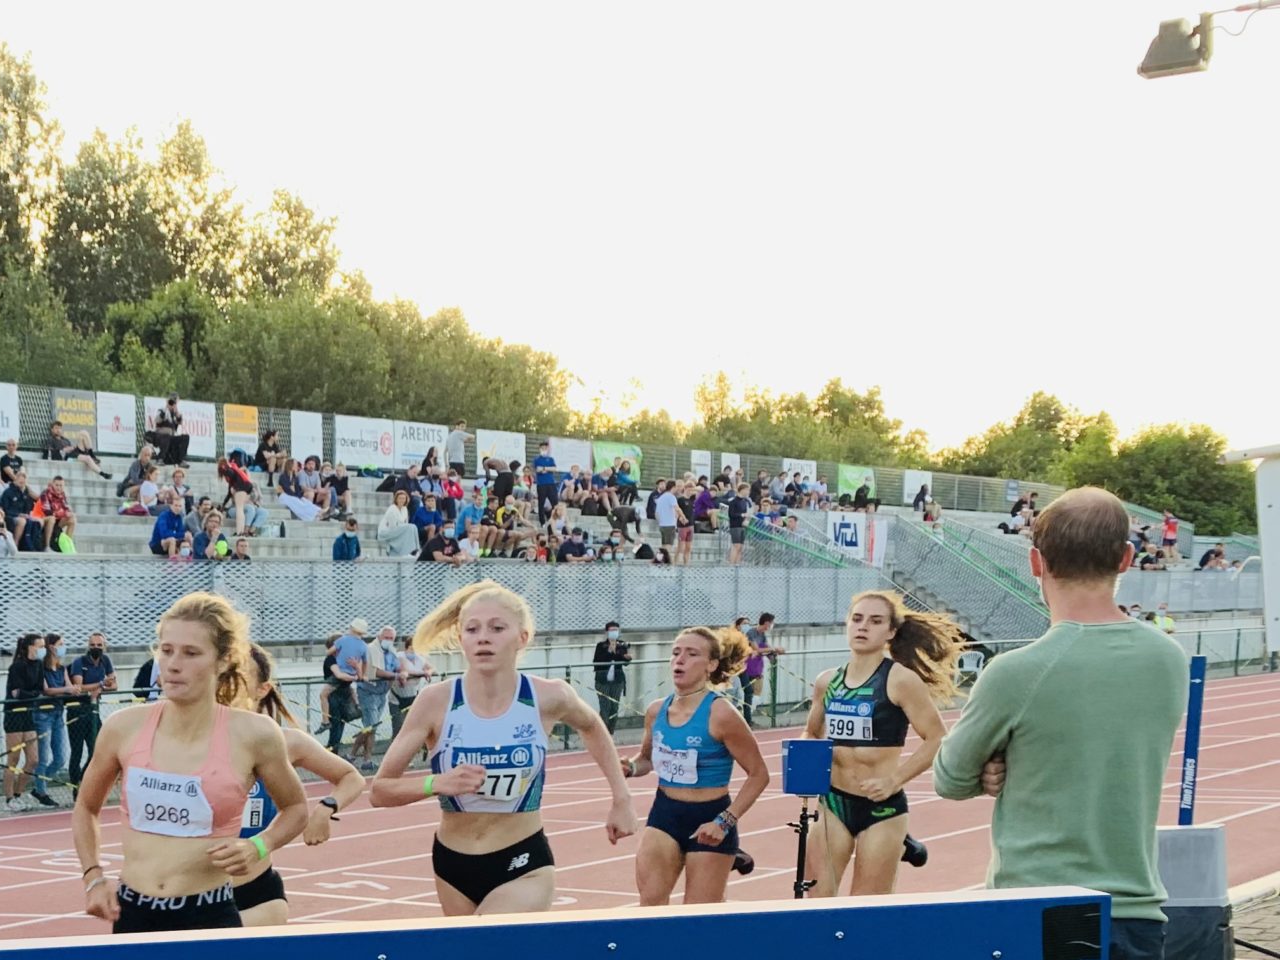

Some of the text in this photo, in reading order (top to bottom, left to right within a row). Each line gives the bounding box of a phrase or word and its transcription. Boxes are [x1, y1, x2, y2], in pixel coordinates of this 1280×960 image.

[401, 426, 443, 443] ARENTS
[828, 702, 856, 714] Allianz
[829, 718, 855, 736] 599
[456, 752, 508, 766] Allianz
[140, 776, 182, 793] Allianz
[476, 774, 517, 796] 77
[144, 803, 190, 827] 9268
